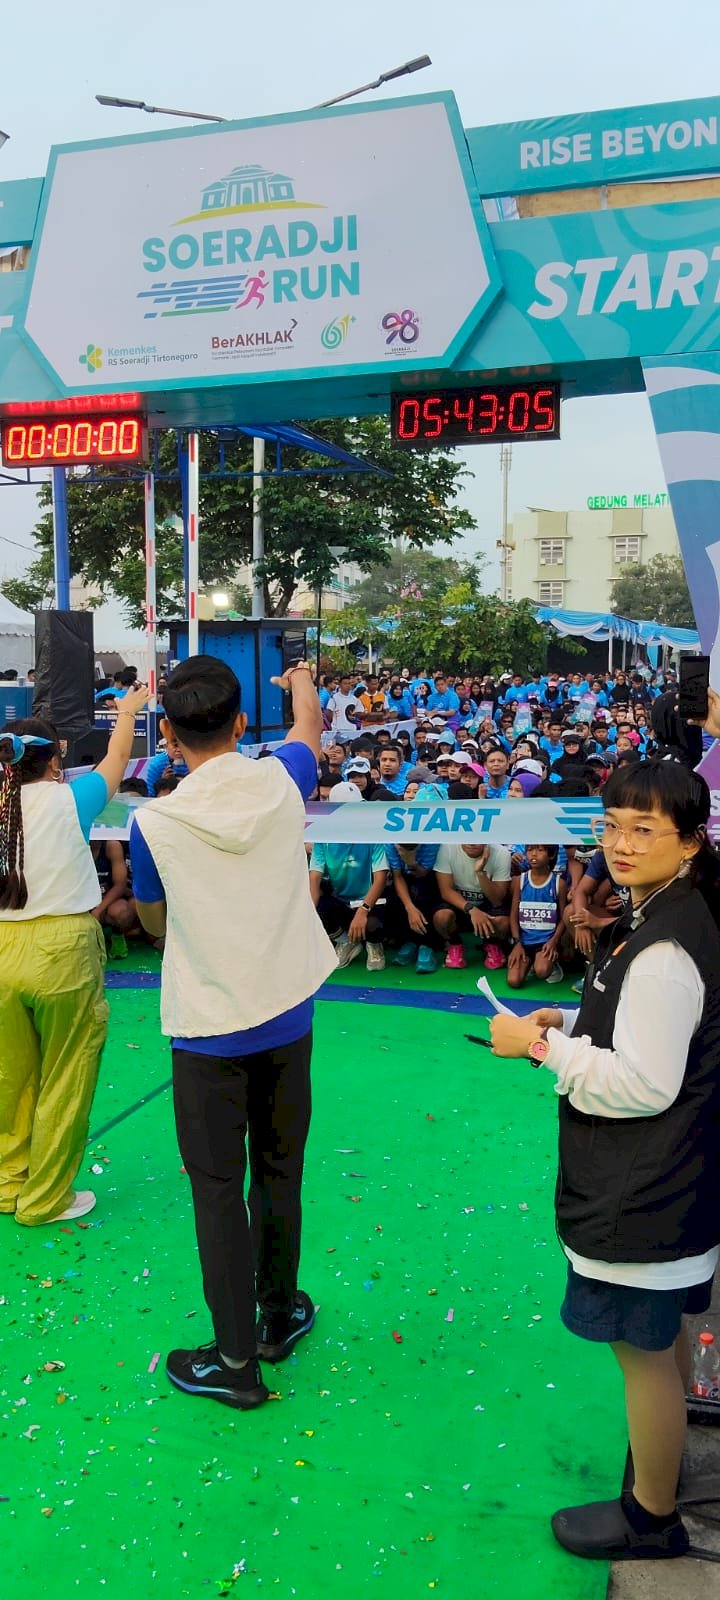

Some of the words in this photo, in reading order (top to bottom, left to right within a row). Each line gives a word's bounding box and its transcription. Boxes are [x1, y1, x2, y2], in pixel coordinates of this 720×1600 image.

[520, 133, 592, 169] RISE
[142, 215, 358, 272] SOERADJI
[273, 262, 361, 303] RUN
[527, 247, 720, 320] STAR
[107, 345, 157, 356] Kemenkes
[211, 329, 294, 349] BerAKHLAK
[108, 358, 118, 366] RS
[119, 355, 150, 365] Soeradji
[152, 353, 198, 363] Tirtonegoro
[398, 390, 553, 439] 05:43:05
[7, 420, 138, 459] 00:00:00
[587, 495, 627, 508] GEDUNG
[384, 807, 501, 832] START
[523, 909, 552, 919] 51261
